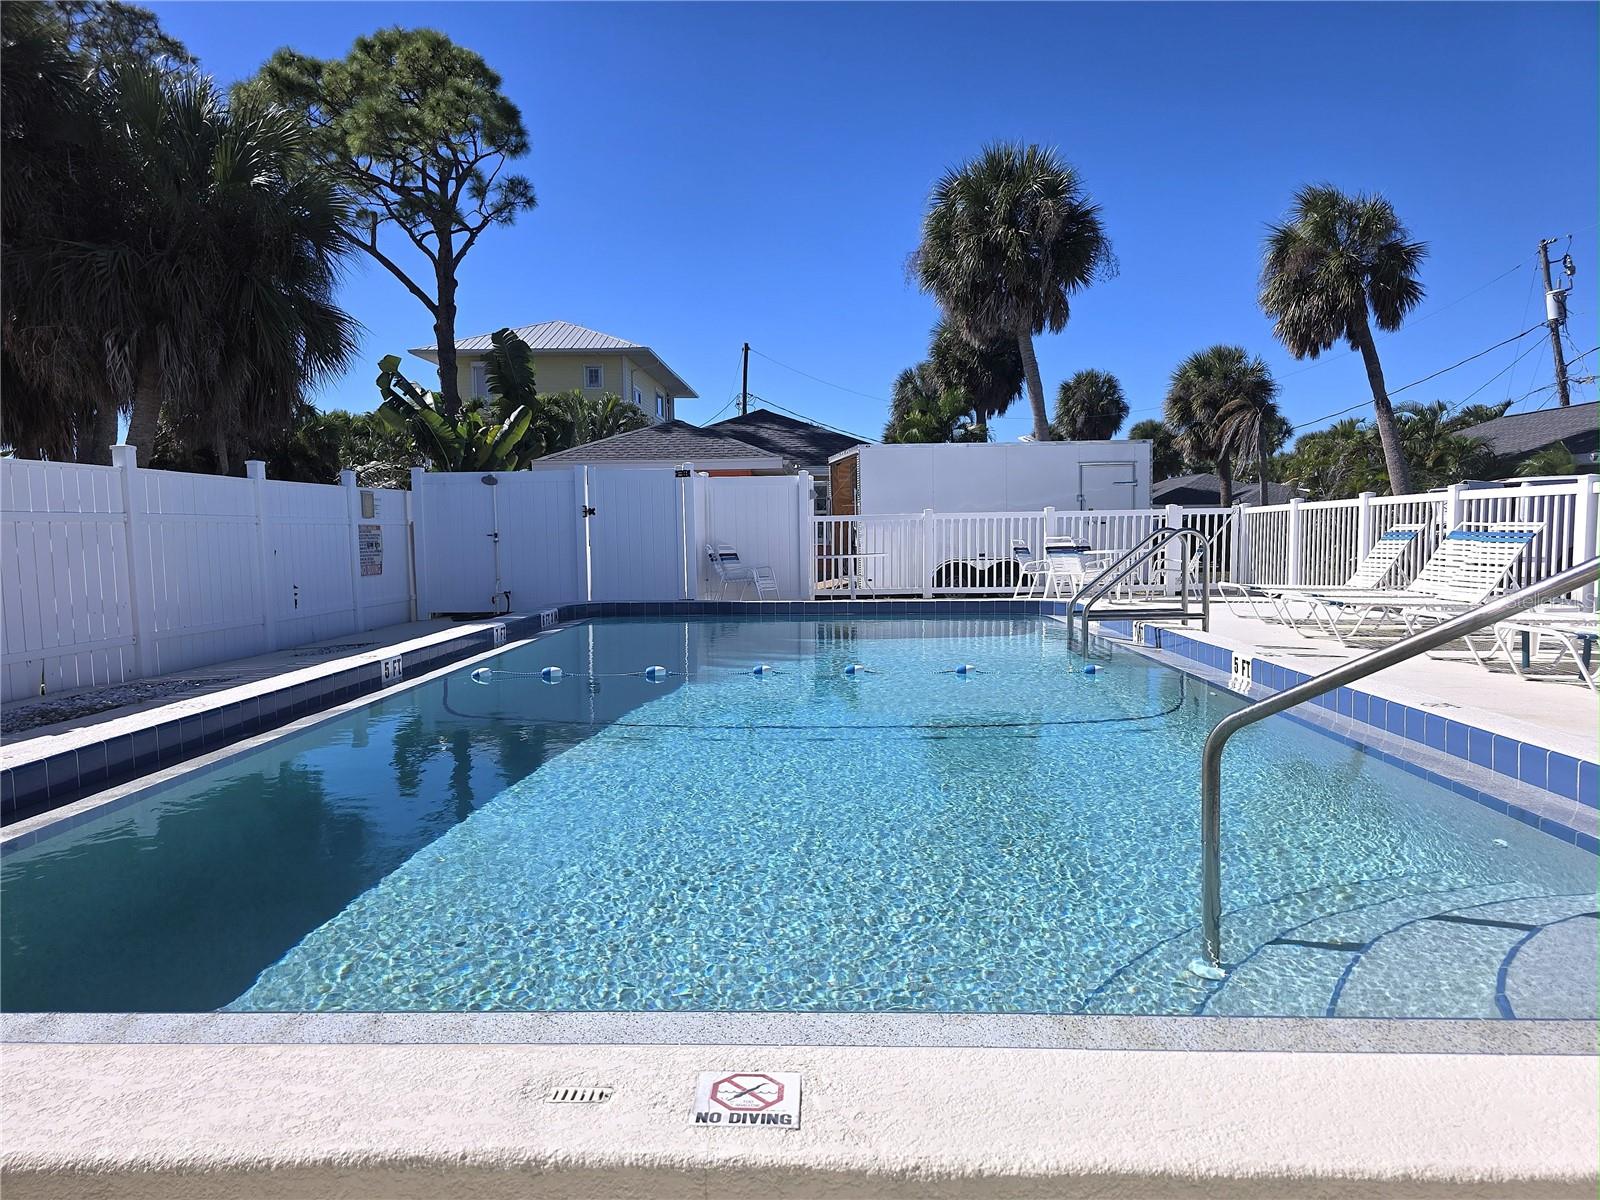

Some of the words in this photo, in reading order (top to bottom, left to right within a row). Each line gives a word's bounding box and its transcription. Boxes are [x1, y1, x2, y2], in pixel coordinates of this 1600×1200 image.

[384, 662, 390, 679] 5
[393, 659, 402, 677] FT
[1234, 656, 1239, 674] 5
[1241, 659, 1251, 679] FT
[695, 1112, 722, 1124] NO
[728, 1113, 792, 1125] DIVING
